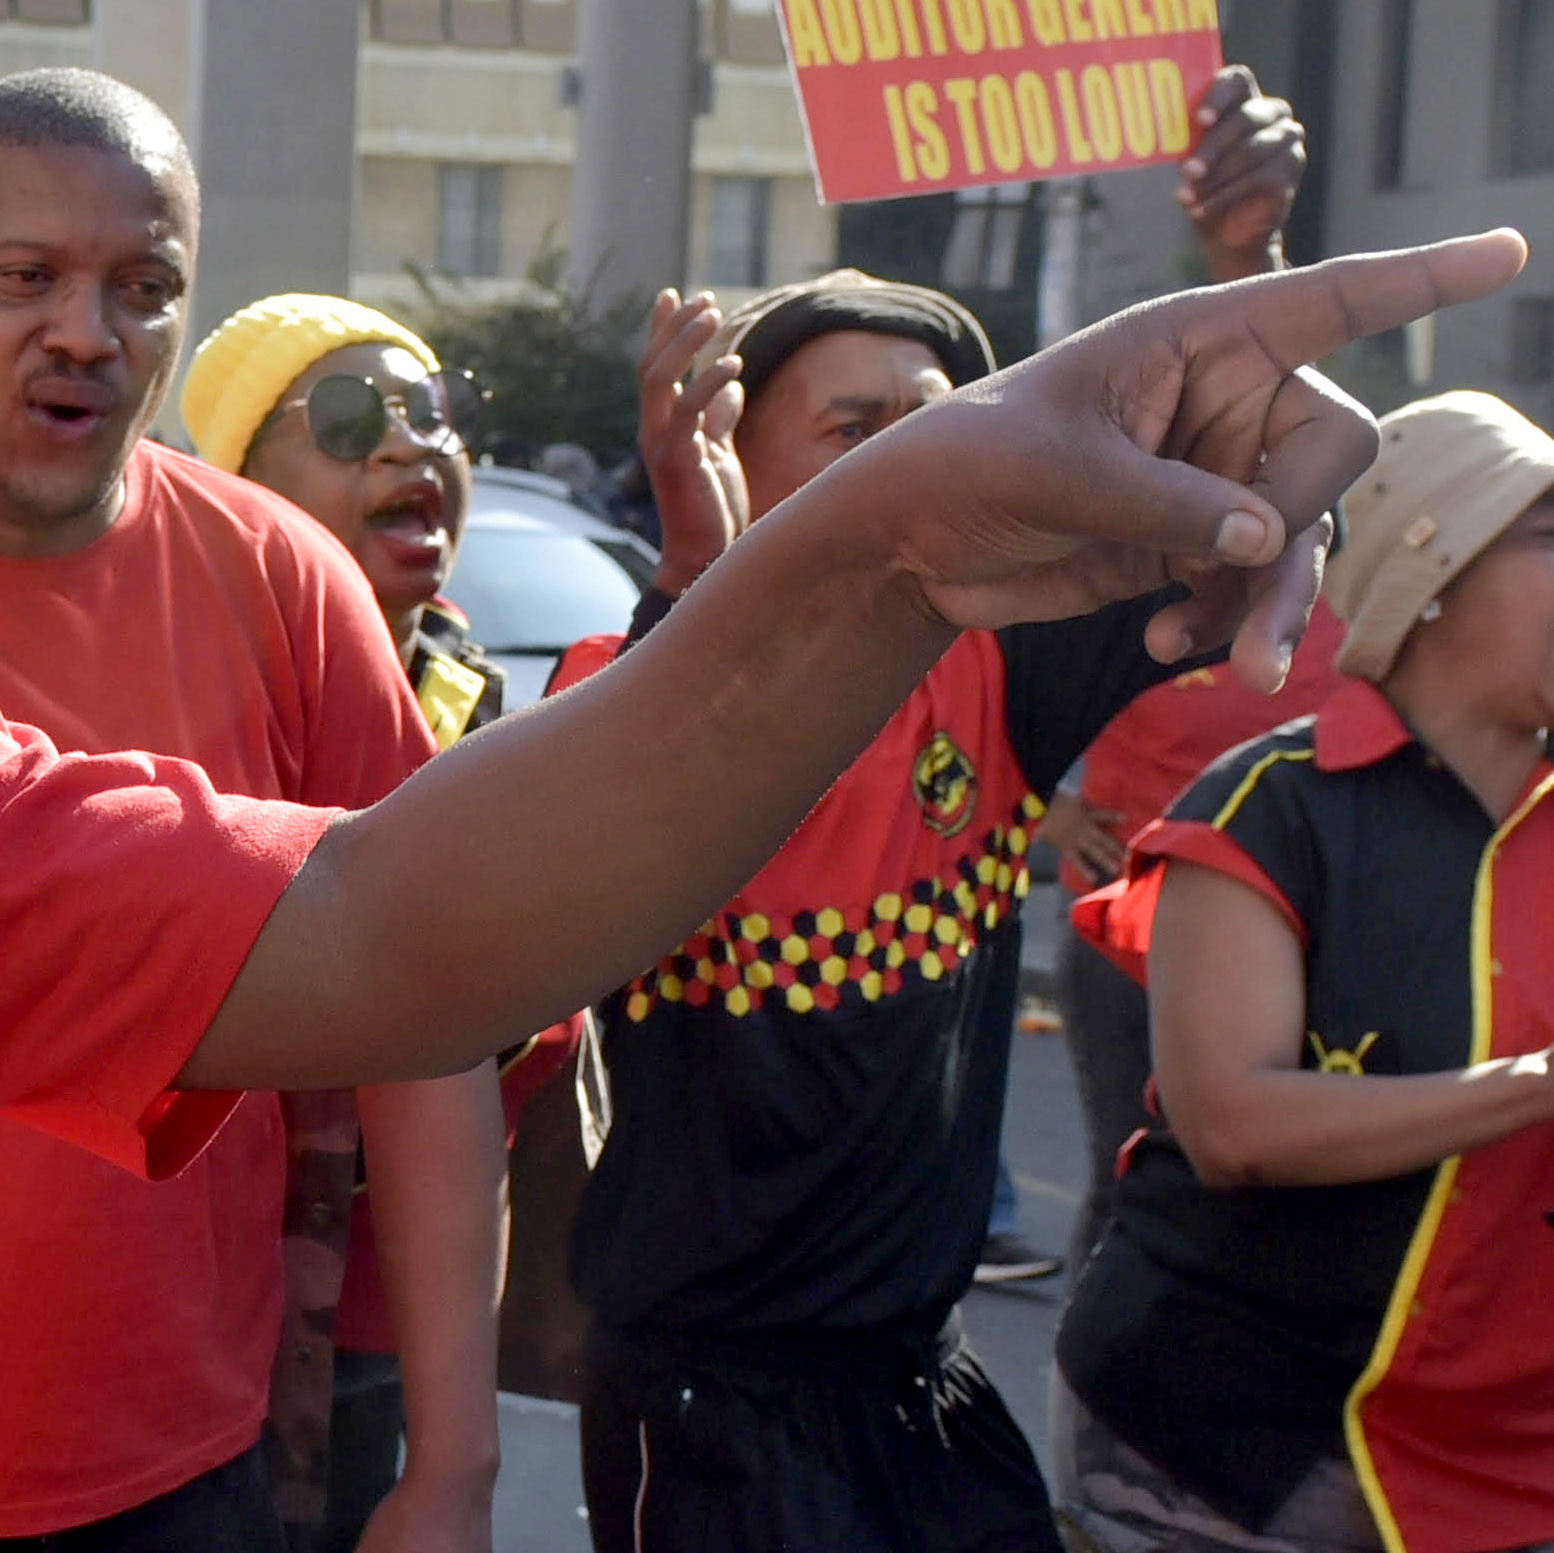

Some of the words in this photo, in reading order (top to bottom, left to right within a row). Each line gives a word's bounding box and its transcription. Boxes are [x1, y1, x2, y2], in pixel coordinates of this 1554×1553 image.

[883, 80, 951, 183] IS
[945, 69, 1057, 174] TOO
[1057, 59, 1192, 163] LOUD
